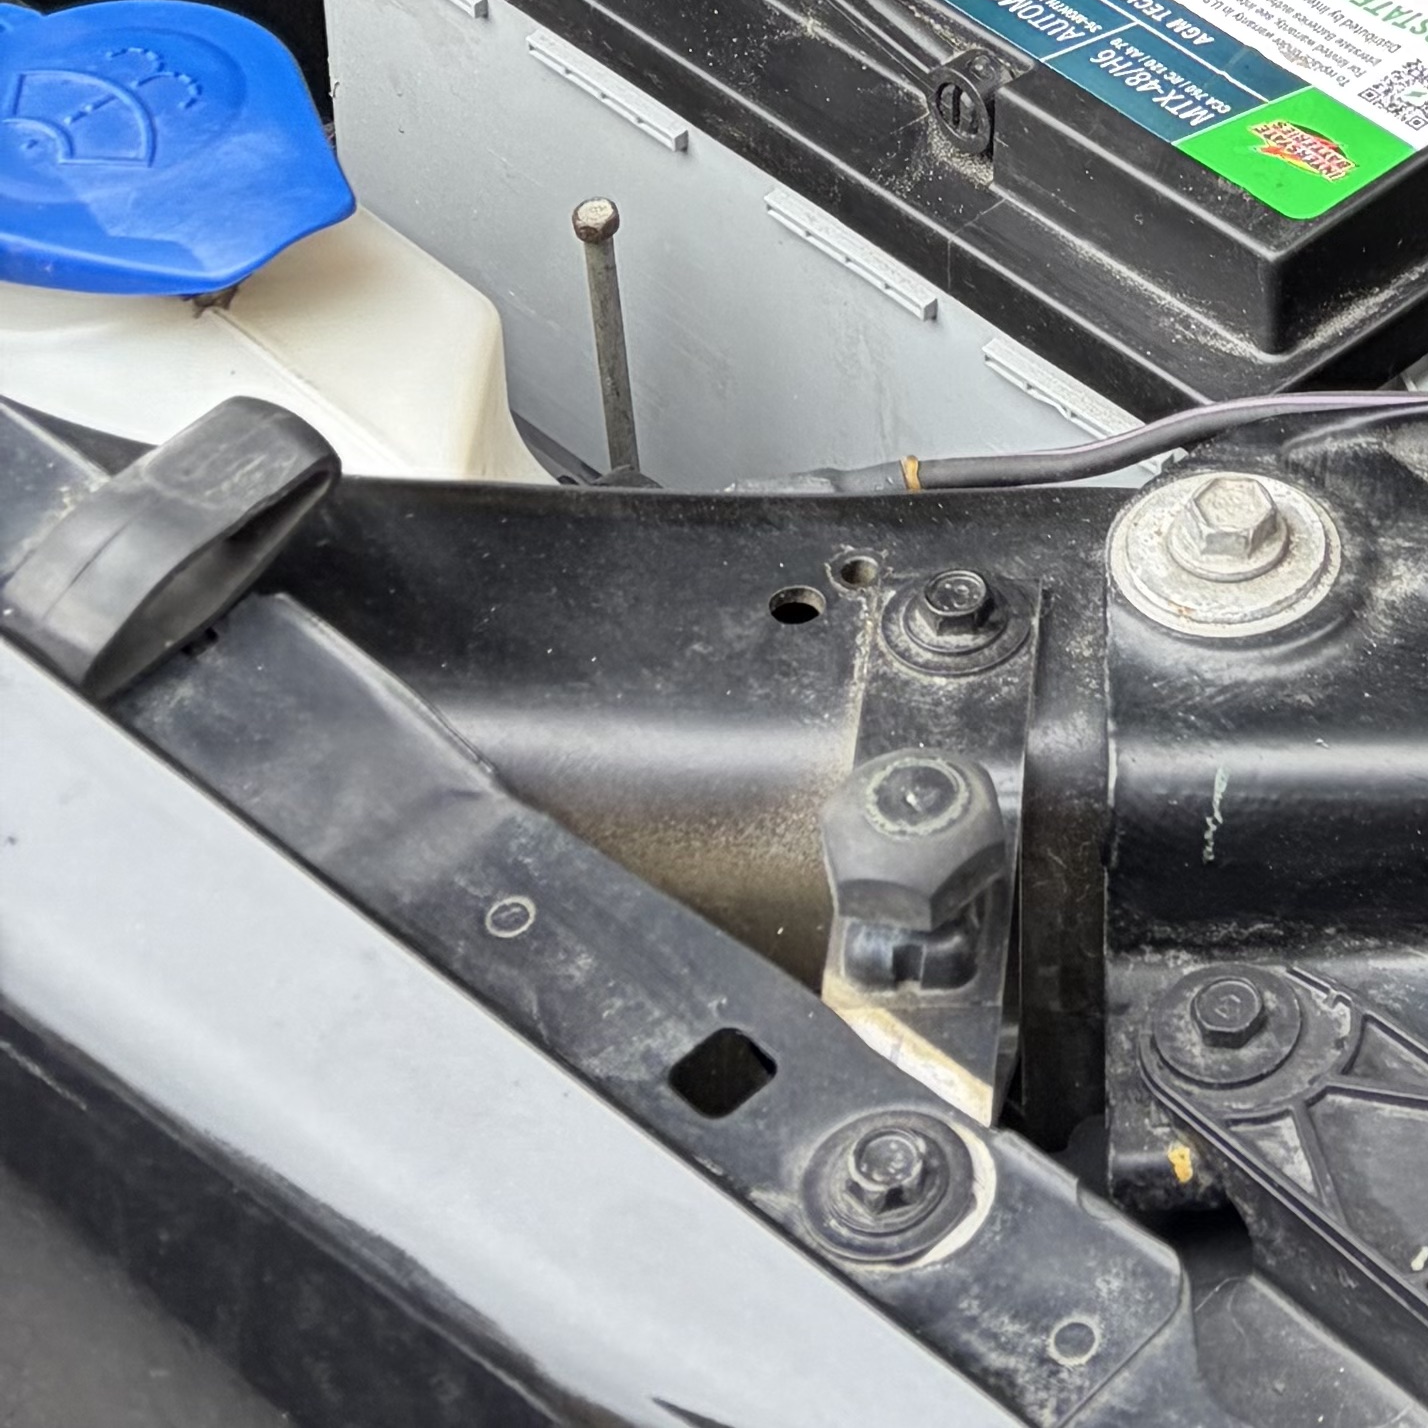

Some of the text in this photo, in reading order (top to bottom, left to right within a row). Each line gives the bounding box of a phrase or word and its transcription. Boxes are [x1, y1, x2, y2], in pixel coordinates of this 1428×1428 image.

[1221, 5, 1235, 17] in
[1327, 9, 1345, 24] by
[1165, 17, 1214, 45] AGM
[1162, 70, 1185, 85] RC
[1346, 64, 1367, 79] For
[1090, 49, 1214, 126] MTX-48/H6
[1335, 74, 1351, 88] To
[1204, 96, 1231, 114] CCA
[1251, 121, 1345, 181] INTERSTATE
[1270, 119, 1353, 172] BATTERIES
